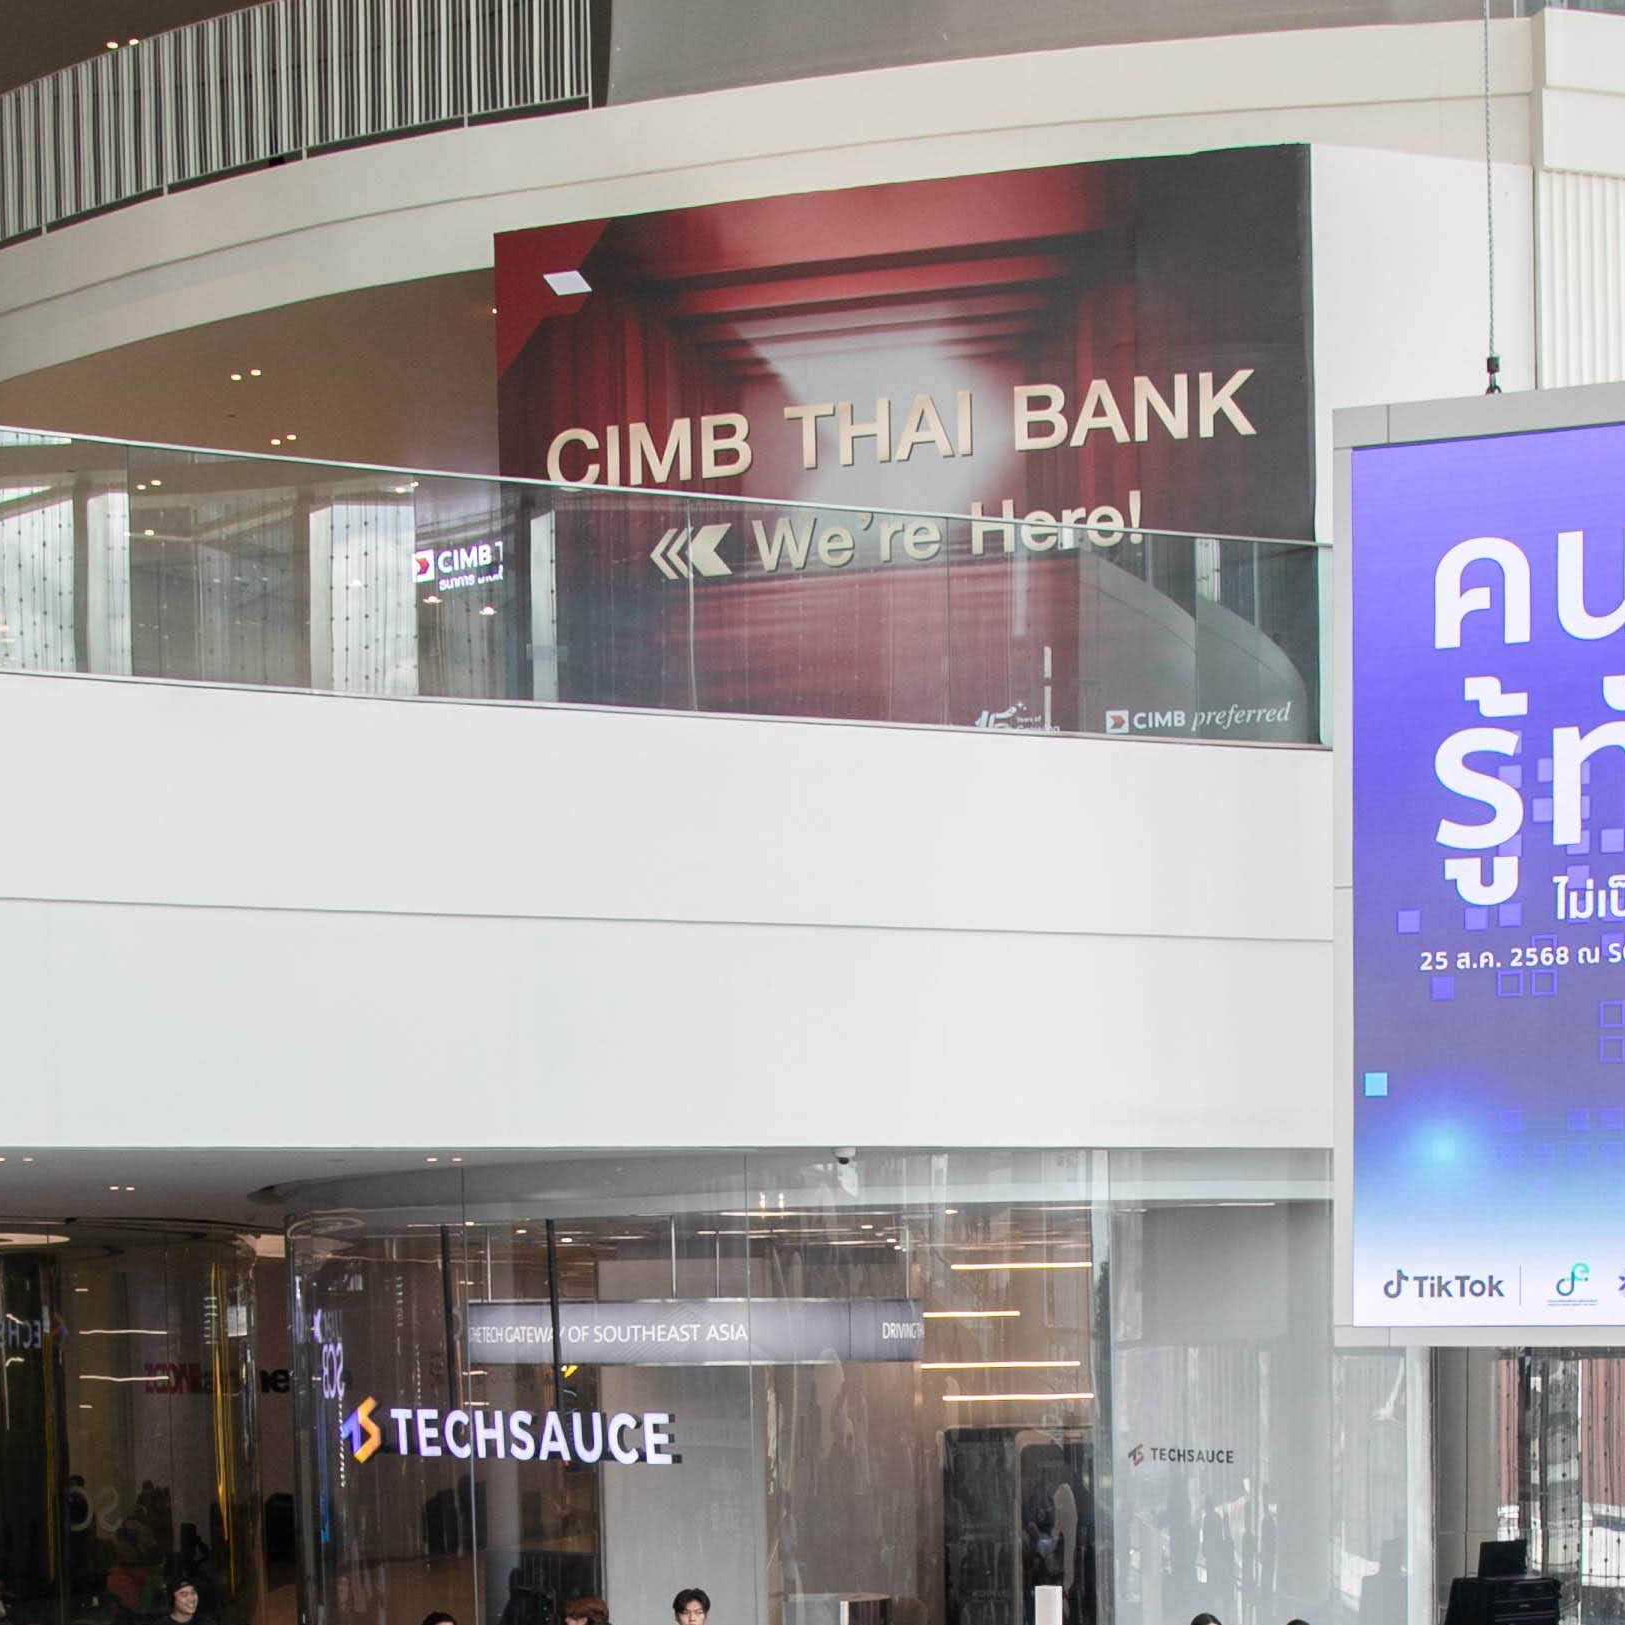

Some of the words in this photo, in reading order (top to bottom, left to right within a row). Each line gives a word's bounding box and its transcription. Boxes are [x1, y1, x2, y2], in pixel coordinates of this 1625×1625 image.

[547, 411, 754, 492] CIMB
[783, 390, 974, 470] THAI
[1012, 368, 1257, 453] BANK
[971, 490, 1144, 555] Here!
[437, 544, 492, 574] CIMB
[1133, 710, 1186, 729] CIMB
[1191, 701, 1293, 731] preferred
[1419, 951, 1450, 971] 25
[1457, 948, 1503, 970] ส.ค.
[1510, 945, 1570, 967] 2568
[1577, 943, 1602, 964] ณ
[1413, 1274, 1505, 1299] TikTok
[568, 1325, 591, 1343] OF
[593, 1323, 701, 1344] SOUTHEAST
[706, 1323, 749, 1343] ASIA
[391, 1407, 673, 1466] TECHSAUCE
[1150, 1447, 1235, 1464] TECHSAUCE
